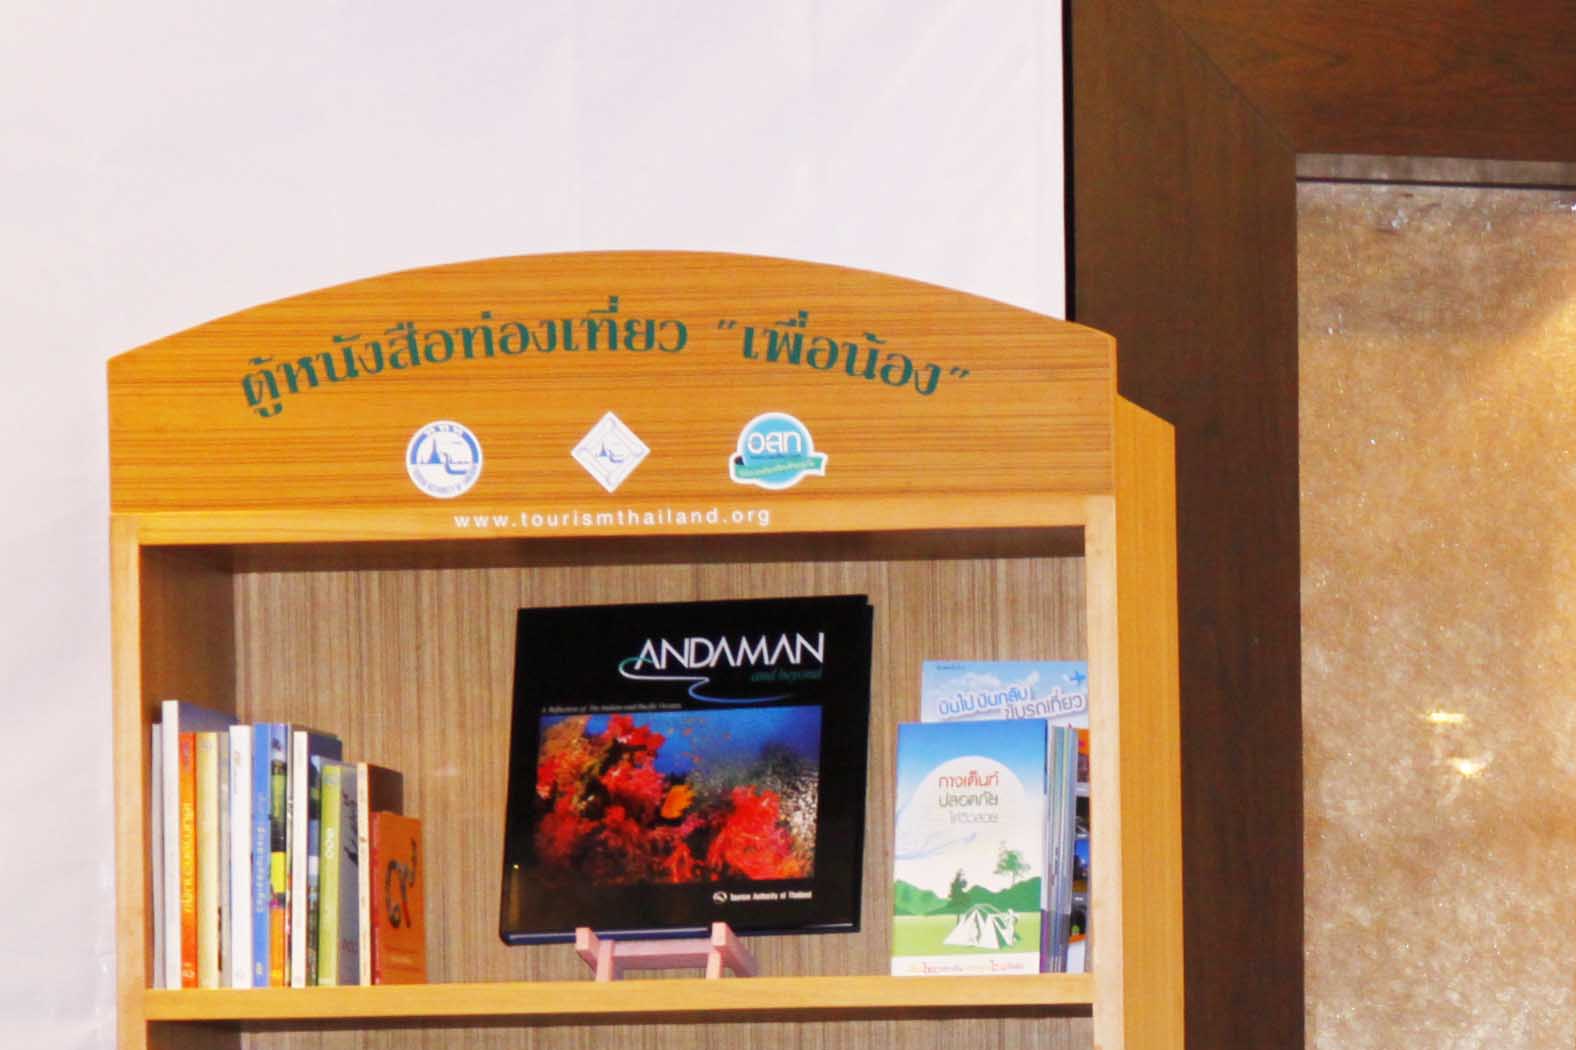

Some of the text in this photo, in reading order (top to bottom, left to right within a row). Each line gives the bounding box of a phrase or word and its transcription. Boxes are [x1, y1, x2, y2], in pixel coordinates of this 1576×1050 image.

[240, 295, 689, 419] ตู้หนังสือท่องเที่ยว
[454, 506, 770, 529] www.tourismthailand.org
[634, 632, 825, 670] ANDAMAN
